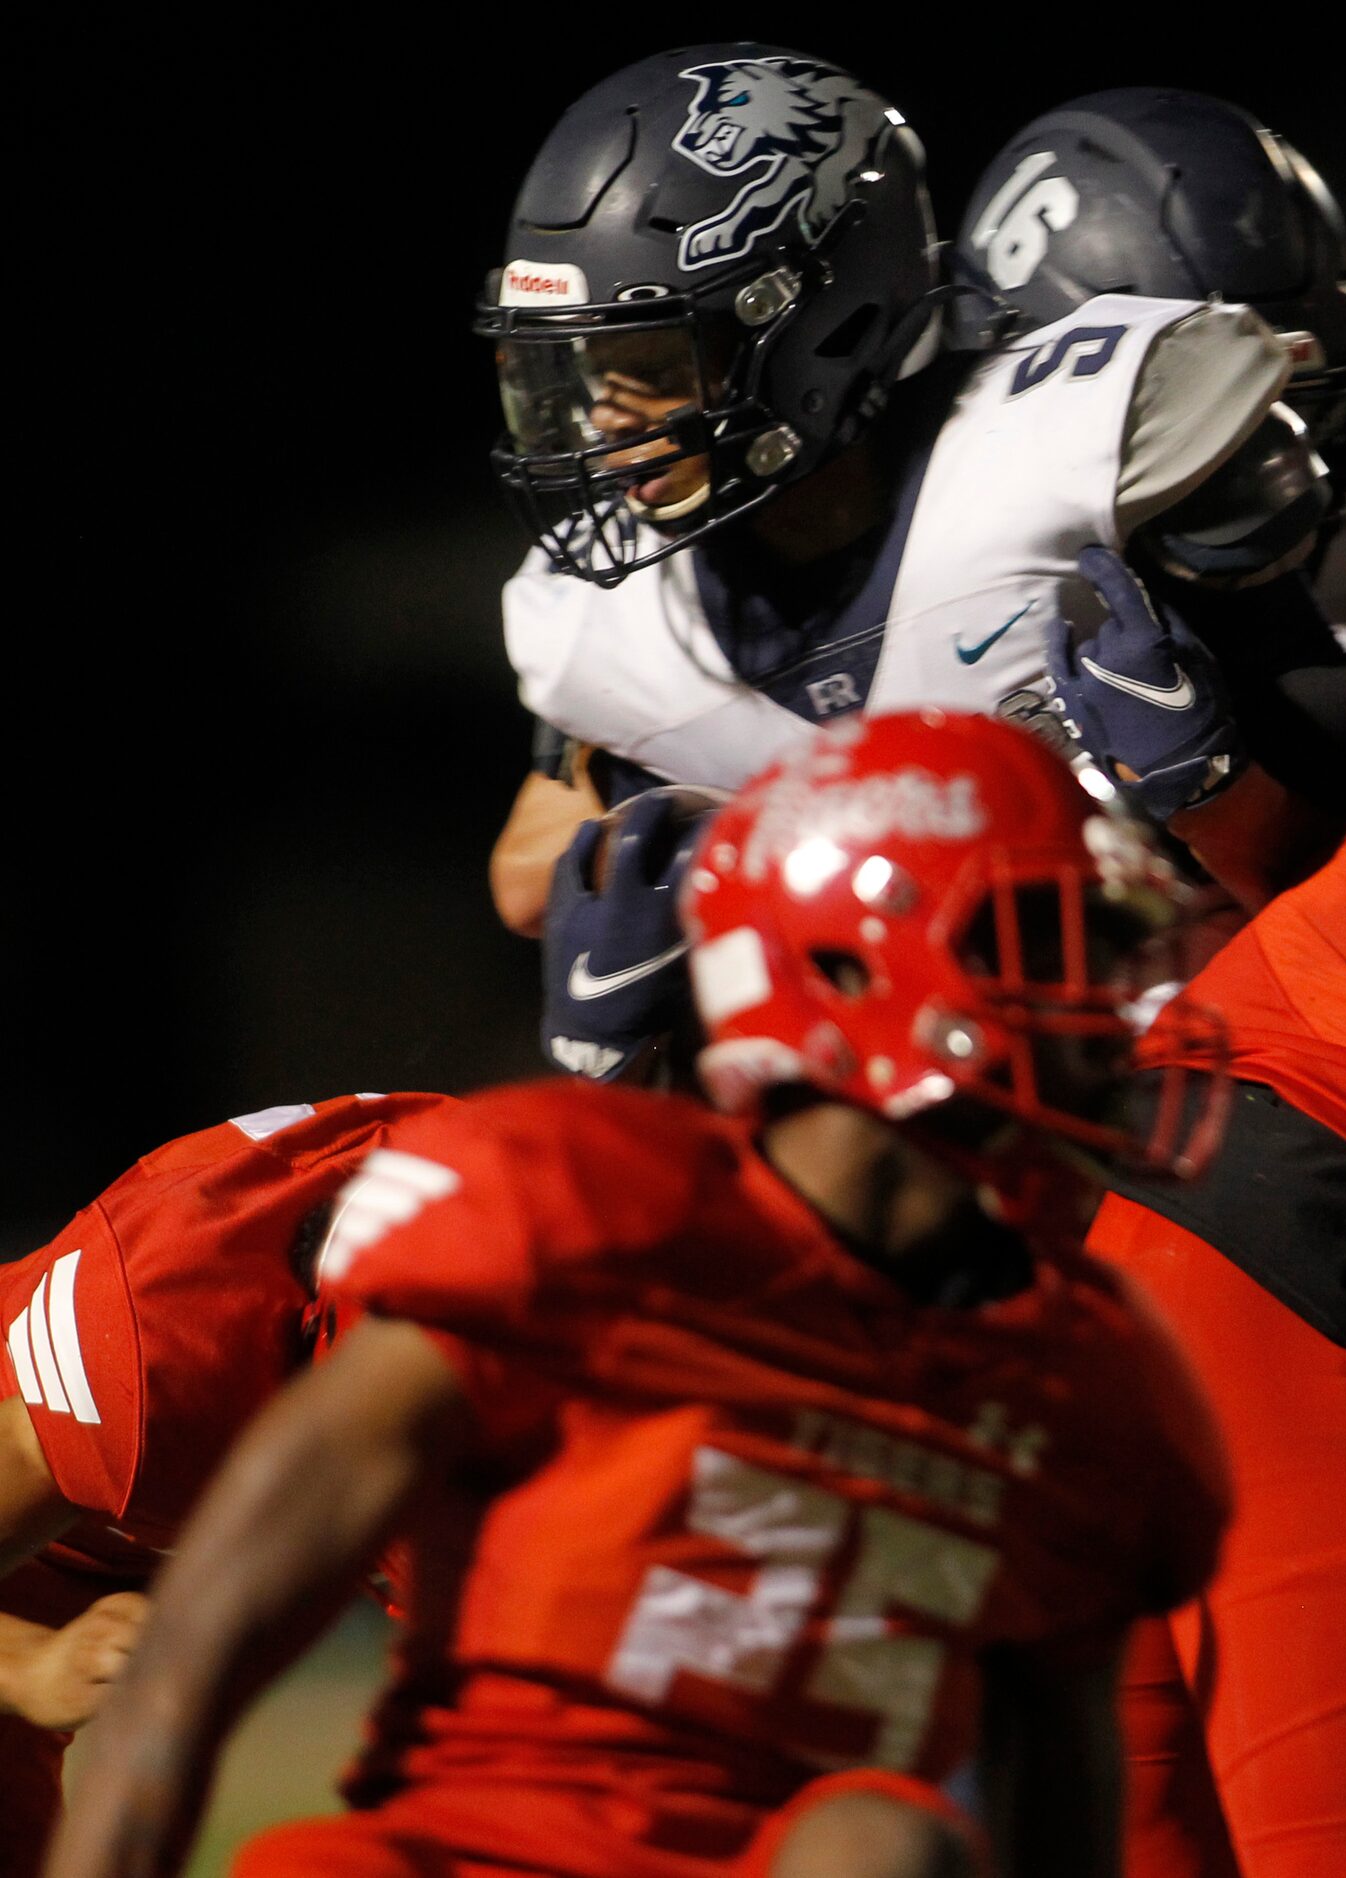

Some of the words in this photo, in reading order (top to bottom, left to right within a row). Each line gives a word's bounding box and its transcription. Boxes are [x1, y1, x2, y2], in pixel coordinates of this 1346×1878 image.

[970, 150, 1080, 290] 16
[1010, 325, 1127, 396] 5
[606, 1445, 1000, 1770] 25
